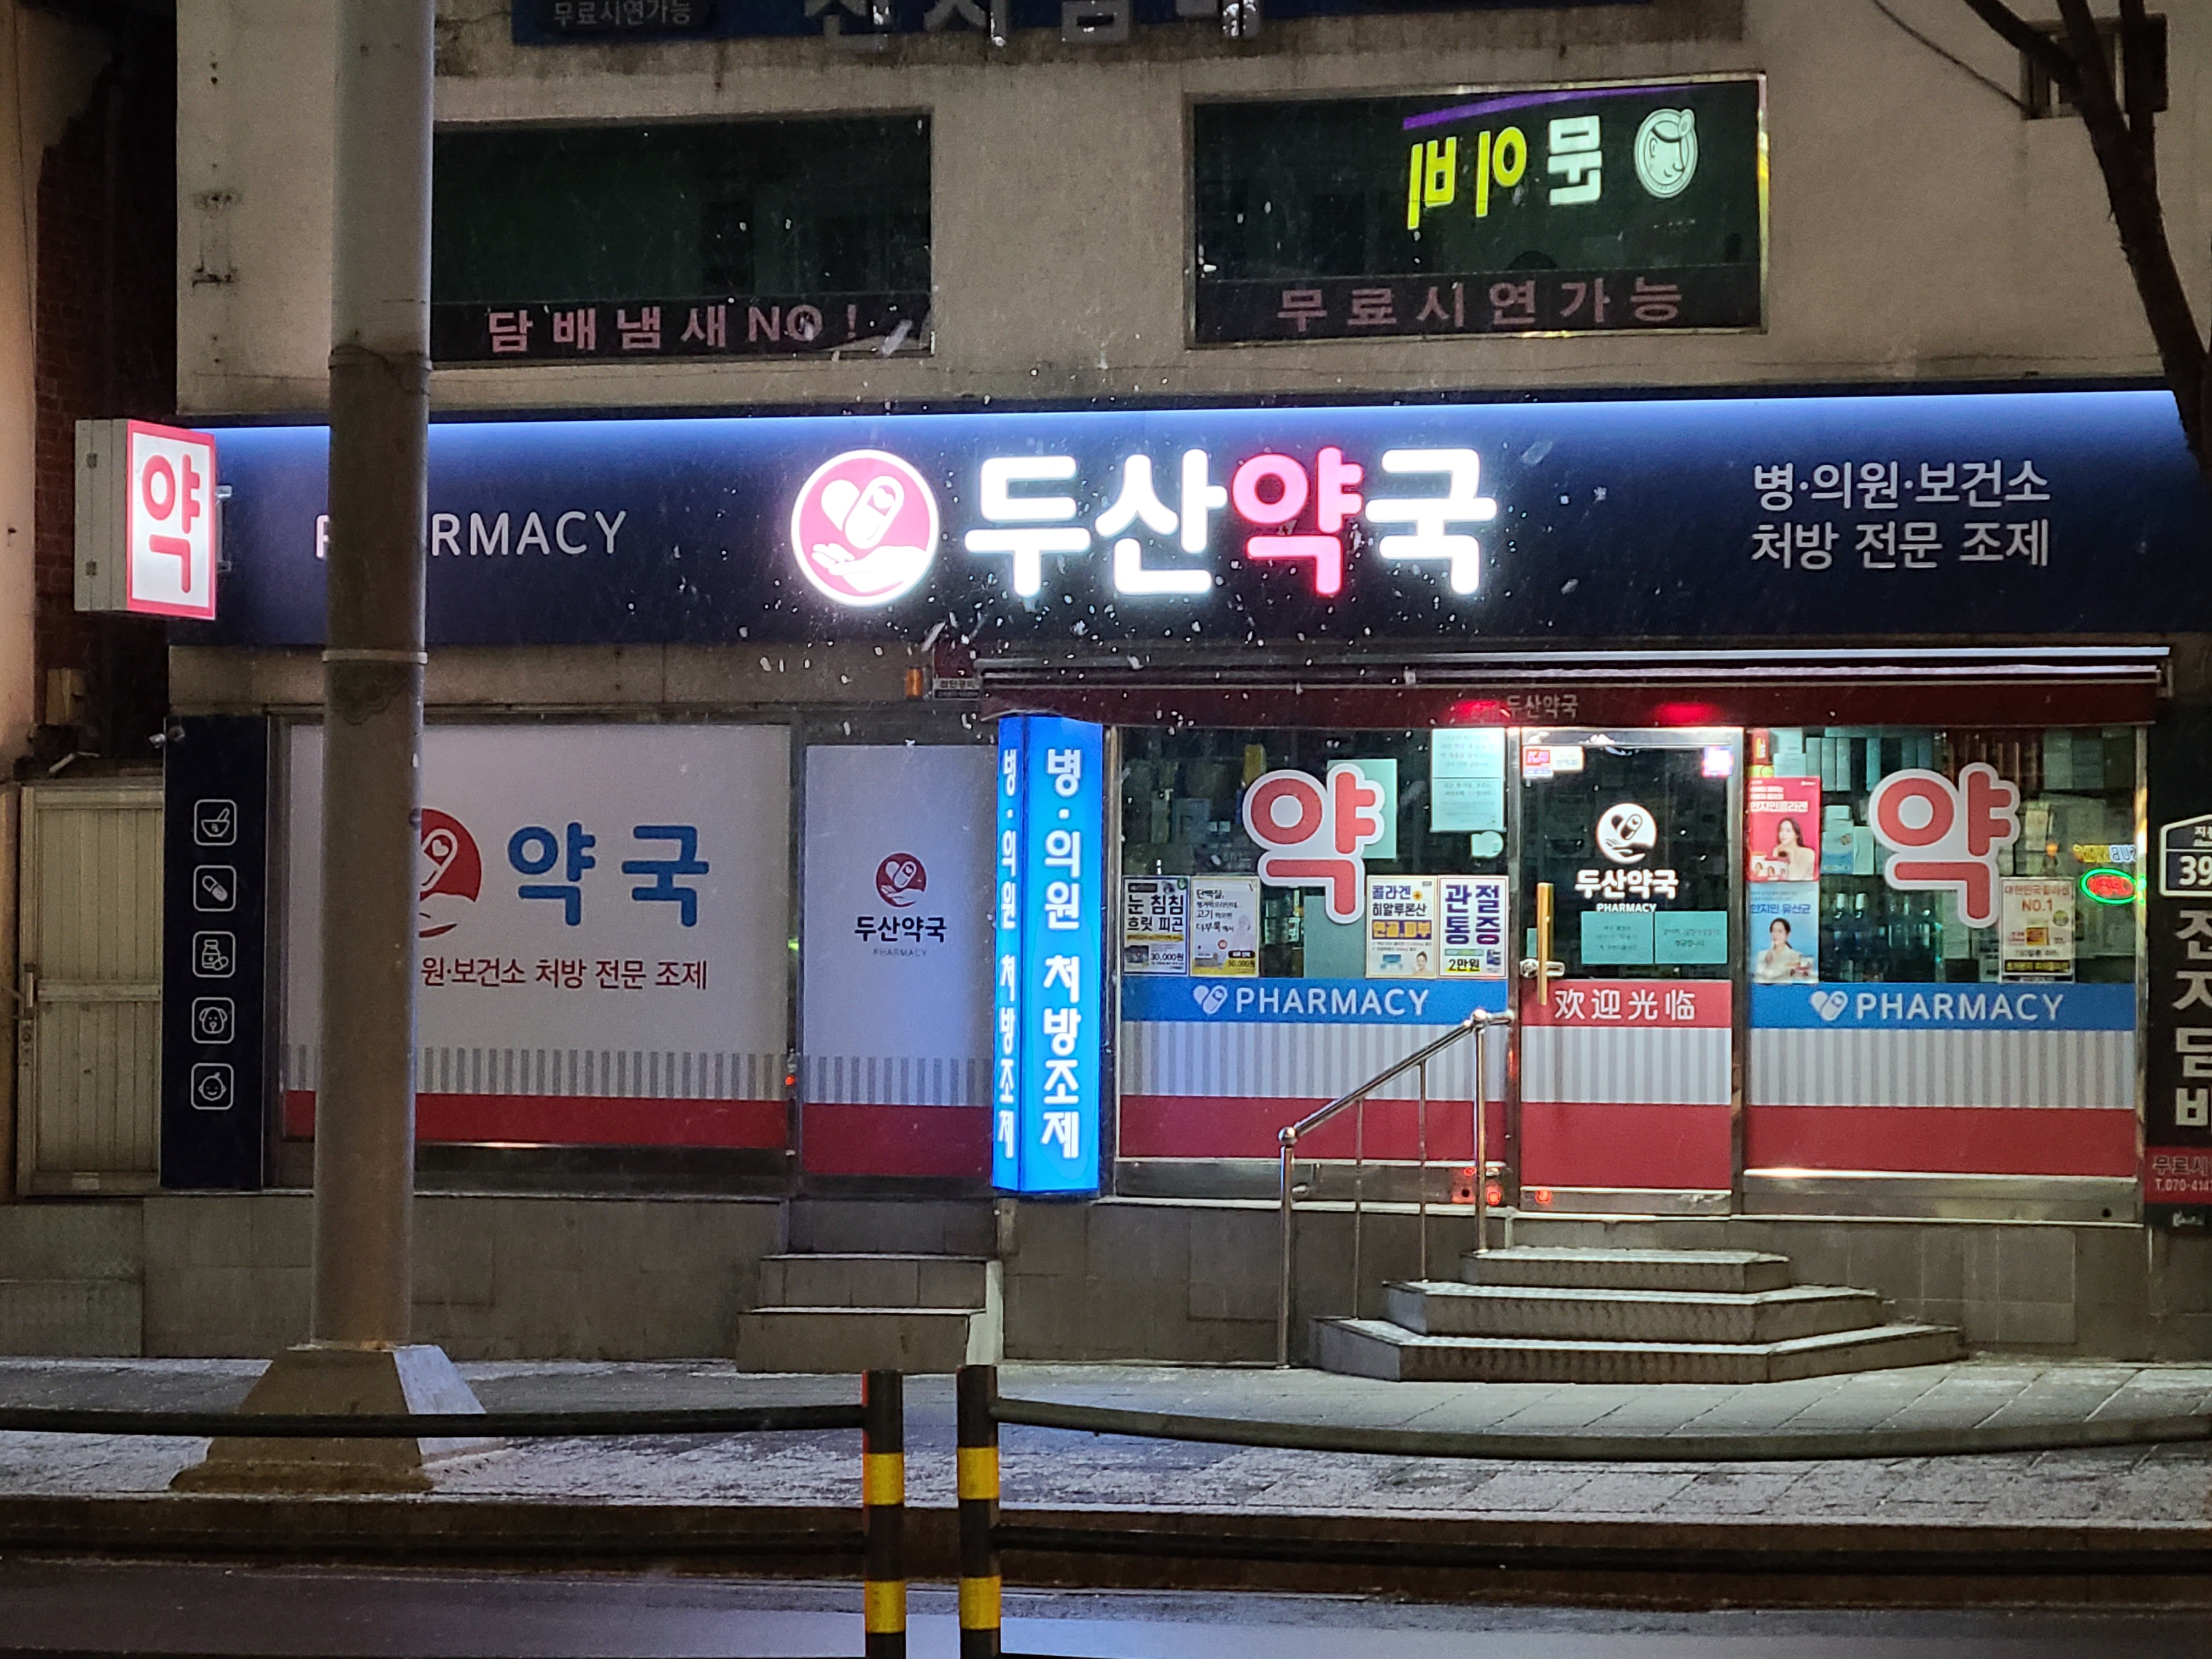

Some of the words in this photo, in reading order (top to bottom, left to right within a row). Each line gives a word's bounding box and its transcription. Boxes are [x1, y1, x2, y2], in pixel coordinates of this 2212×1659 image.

[1277, 276, 1682, 332] 무료시연가능
[141, 453, 201, 594] 약
[964, 446, 1499, 596] 두산약국
[1752, 521, 1839, 570] 처방
[1855, 520, 1943, 568] 전문
[1959, 518, 2049, 567] 조제
[1506, 695, 1579, 718] 두산약국
[1250, 771, 1377, 916] 약
[1877, 770, 2013, 920] 약
[507, 821, 710, 927] 약국
[1575, 869, 1679, 900] 두산약국
[1128, 895, 1144, 915] 눈
[1150, 895, 1183, 915] 침침
[1373, 885, 1411, 900] 콜라겐
[1445, 884, 1500, 914] 관절
[2022, 899, 2053, 912] NO.1
[1197, 910, 1213, 920] 고기
[1373, 902, 1427, 917] 히알루론산
[1596, 902, 1657, 913] PHARMACY
[854, 916, 947, 944] 두산약국
[1127, 917, 1153, 932] 흐릿
[1158, 917, 1183, 932] 피곤
[1444, 916, 1500, 945] 통증
[1150, 952, 1184, 962] 30,000원
[1449, 958, 1480, 972] 2만원
[535, 958, 586, 988] 처방
[595, 958, 646, 989] 전문
[655, 959, 708, 990] 조제
[1235, 987, 1430, 1015] PHARMACY
[1554, 989, 1695, 1021] 欢迎光临
[1857, 993, 2064, 1022] PHARMACY
[997, 955, 1017, 1159] 처방조제
[1041, 955, 1082, 1159] 처방조제
